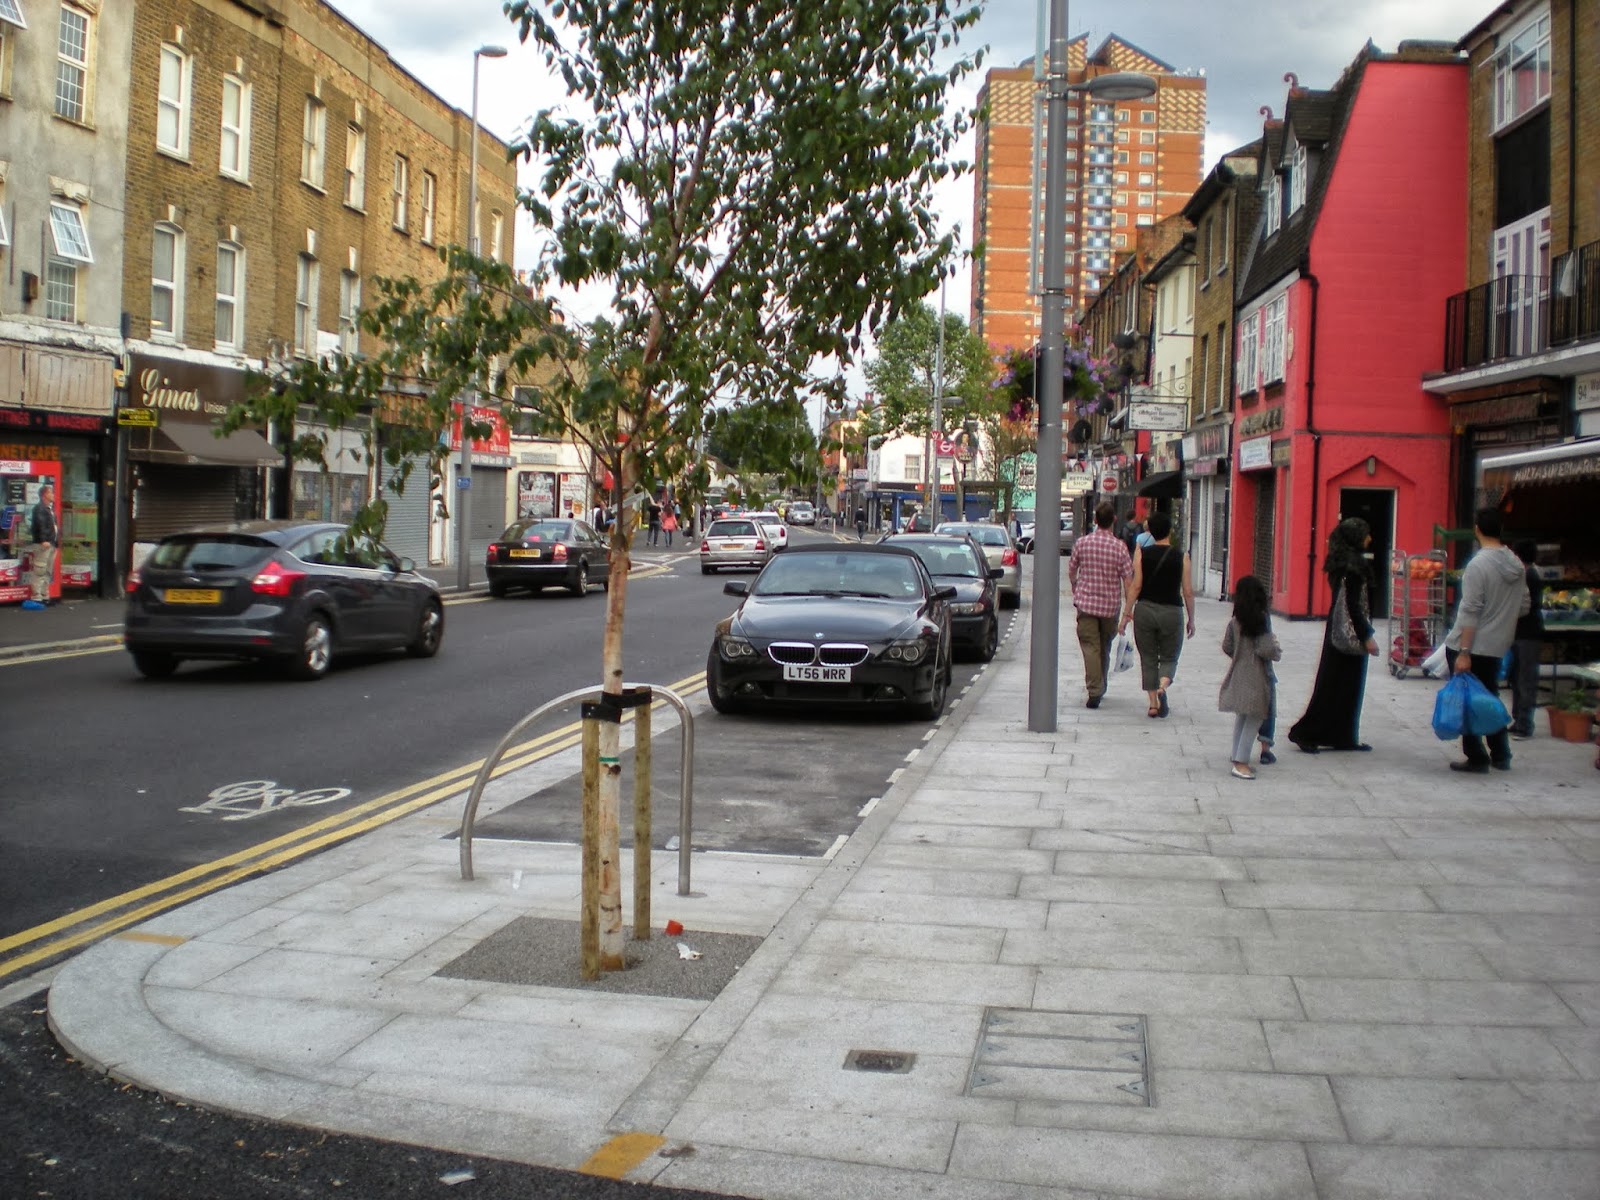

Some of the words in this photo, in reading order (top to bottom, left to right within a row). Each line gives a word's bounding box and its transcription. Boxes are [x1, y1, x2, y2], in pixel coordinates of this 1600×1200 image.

[141, 368, 199, 411] Ginas
[1578, 385, 1587, 400] 94
[788, 667, 819, 680] LT56
[823, 669, 846, 680] WRR
